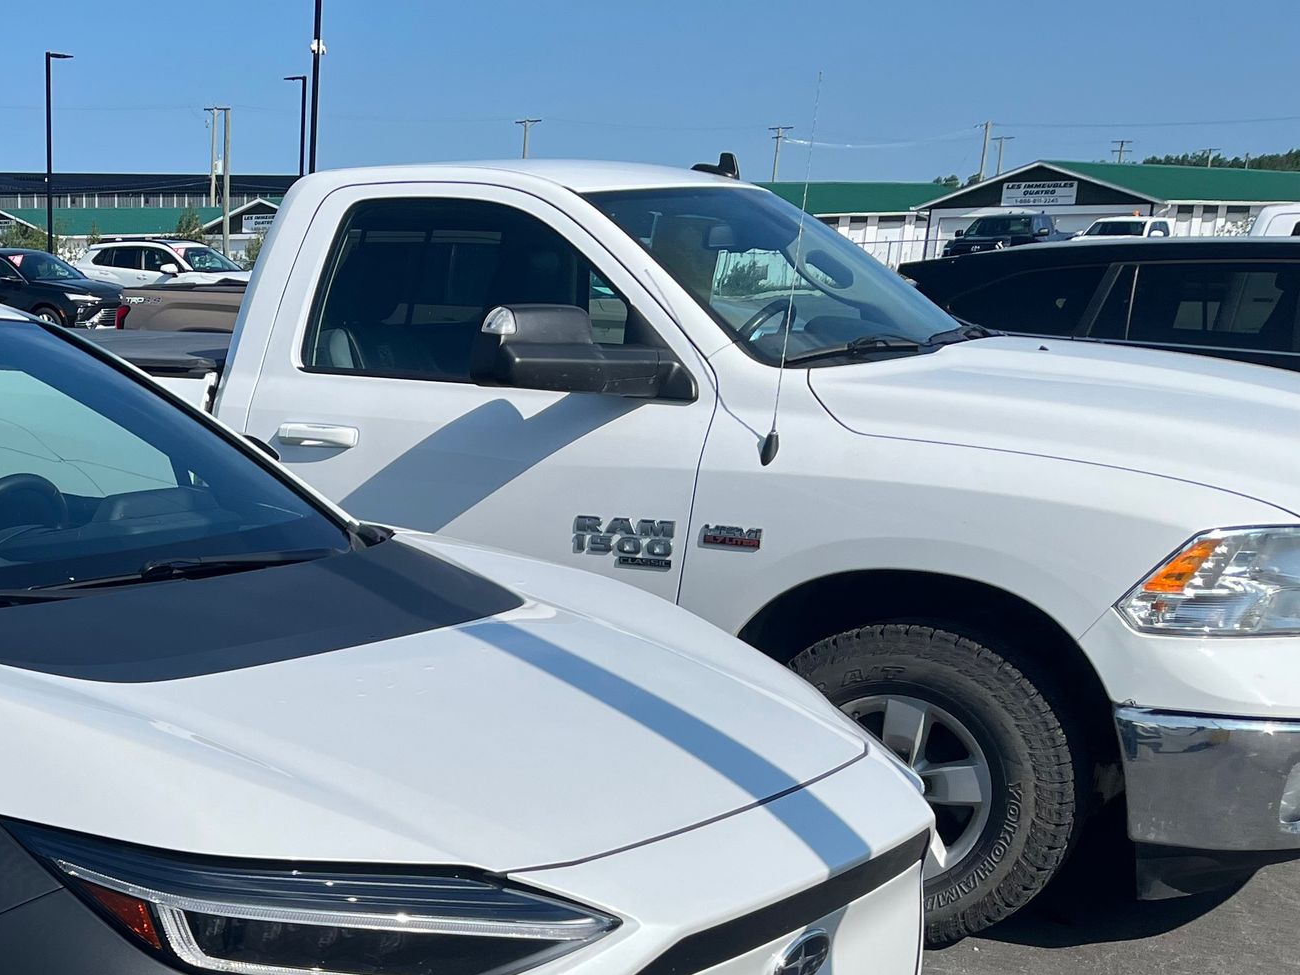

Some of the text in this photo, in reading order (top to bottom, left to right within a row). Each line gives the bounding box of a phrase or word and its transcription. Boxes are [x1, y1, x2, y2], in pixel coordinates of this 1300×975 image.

[573, 515, 676, 538] RAM
[572, 534, 672, 556] 1500
[619, 557, 672, 568] CLASSIC
